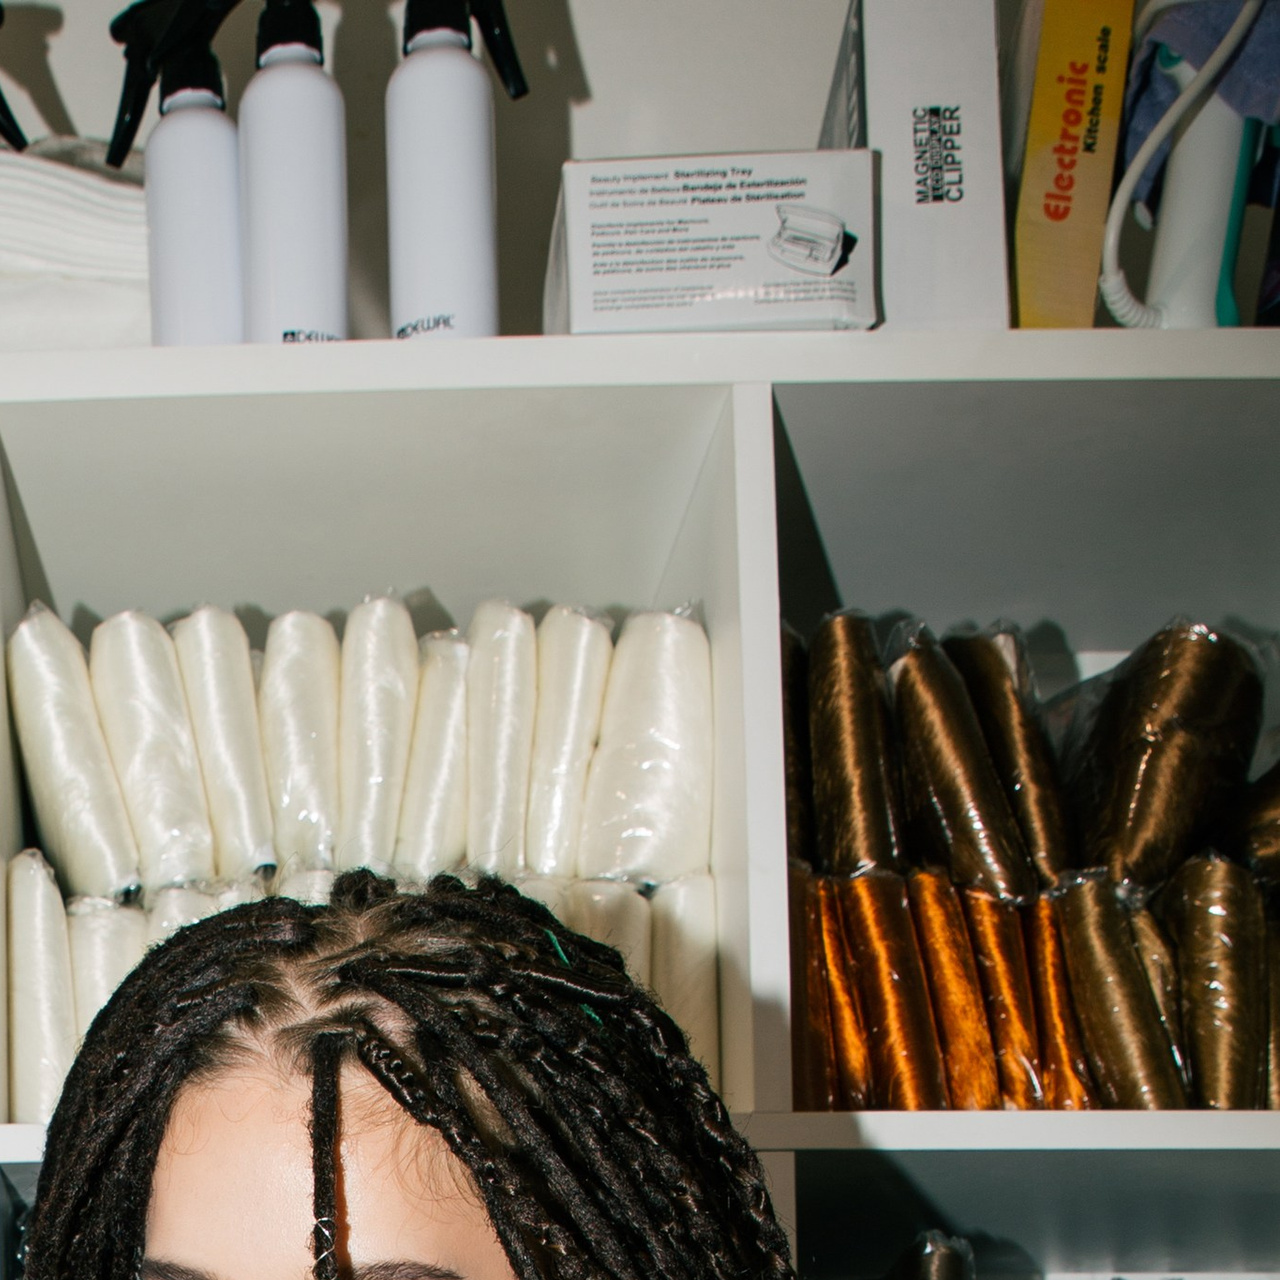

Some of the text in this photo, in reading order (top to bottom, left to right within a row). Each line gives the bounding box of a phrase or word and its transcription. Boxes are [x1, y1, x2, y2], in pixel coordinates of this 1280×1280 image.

[1082, 25, 1112, 153] Kitchen scale
[730, 166, 753, 178] Tray
[912, 105, 929, 204] MAGNETIC
[942, 105, 964, 202] CLIPPER
[1043, 61, 1090, 222] Electronic
